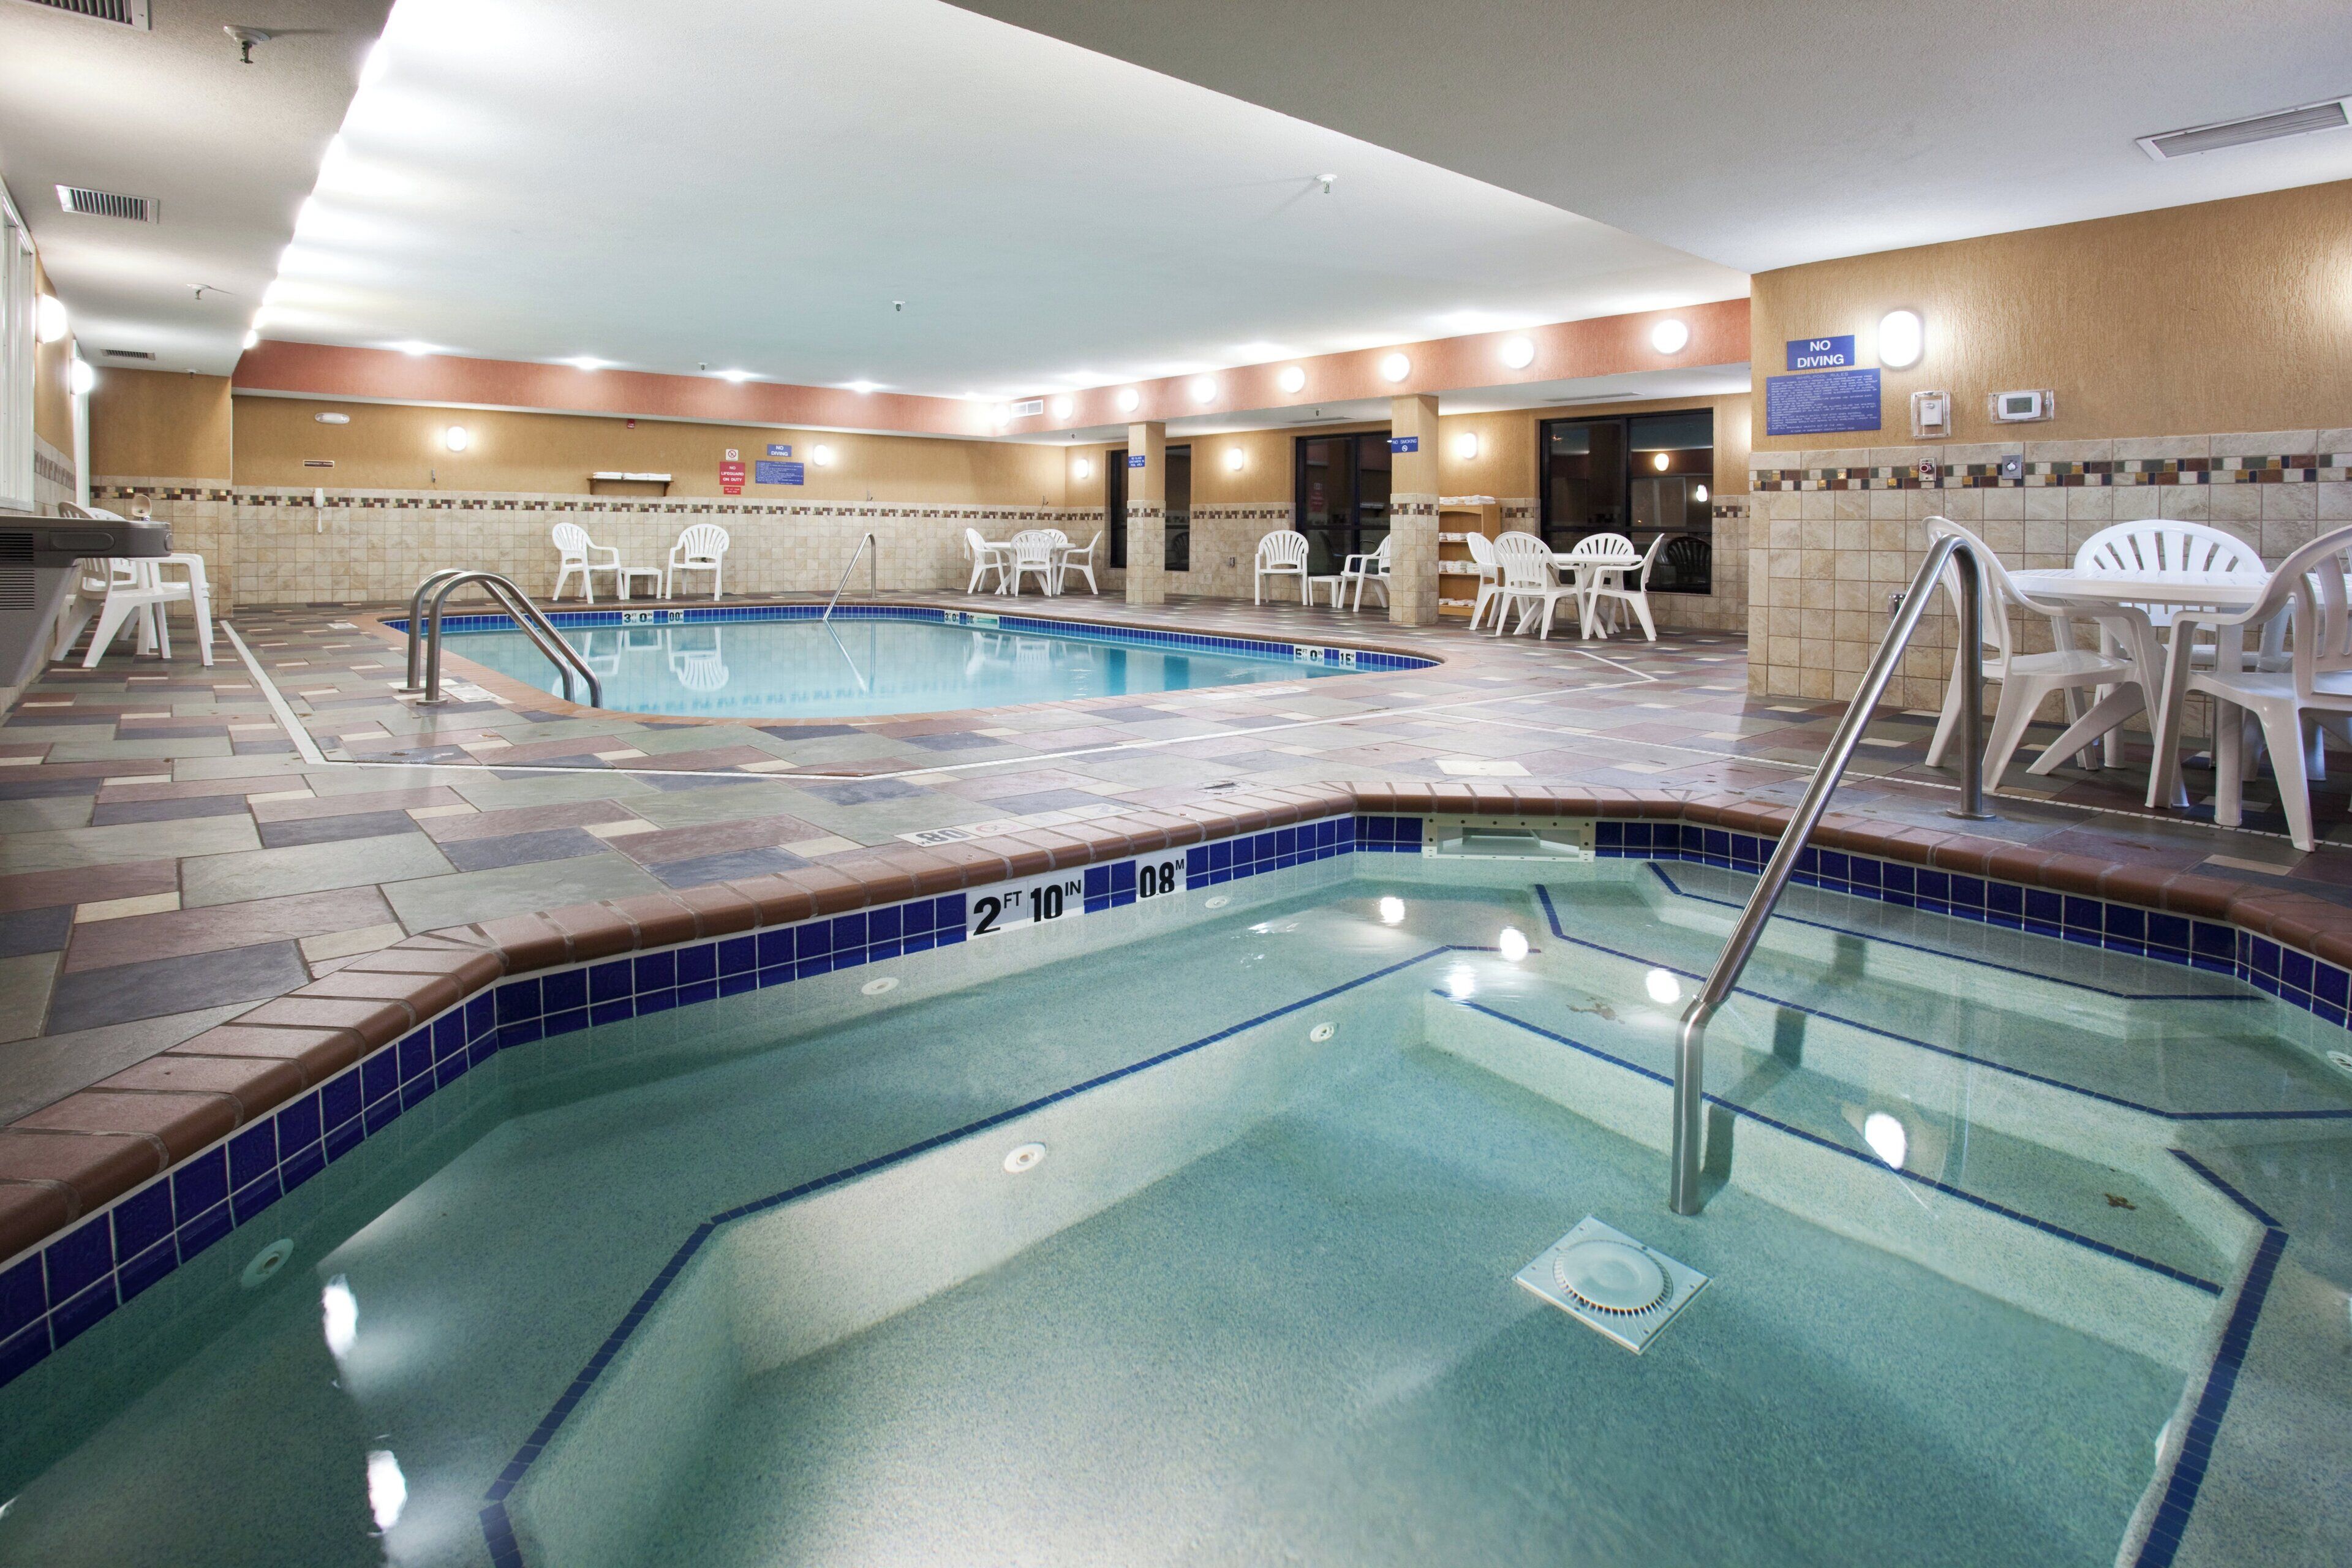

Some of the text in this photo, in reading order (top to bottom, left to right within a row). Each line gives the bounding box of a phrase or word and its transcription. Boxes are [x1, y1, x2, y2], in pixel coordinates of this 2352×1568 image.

[1810, 340, 1831, 352] NO
[1797, 354, 1844, 368] DIVING
[624, 613, 631, 623] 3
[639, 613, 647, 622] 0
[945, 612, 949, 621] 3
[973, 896, 1001, 936] 2
[1004, 891, 1022, 908] FT
[1030, 884, 1063, 923] 10
[1065, 880, 1081, 897] IN
[1175, 859, 1184, 870] M
